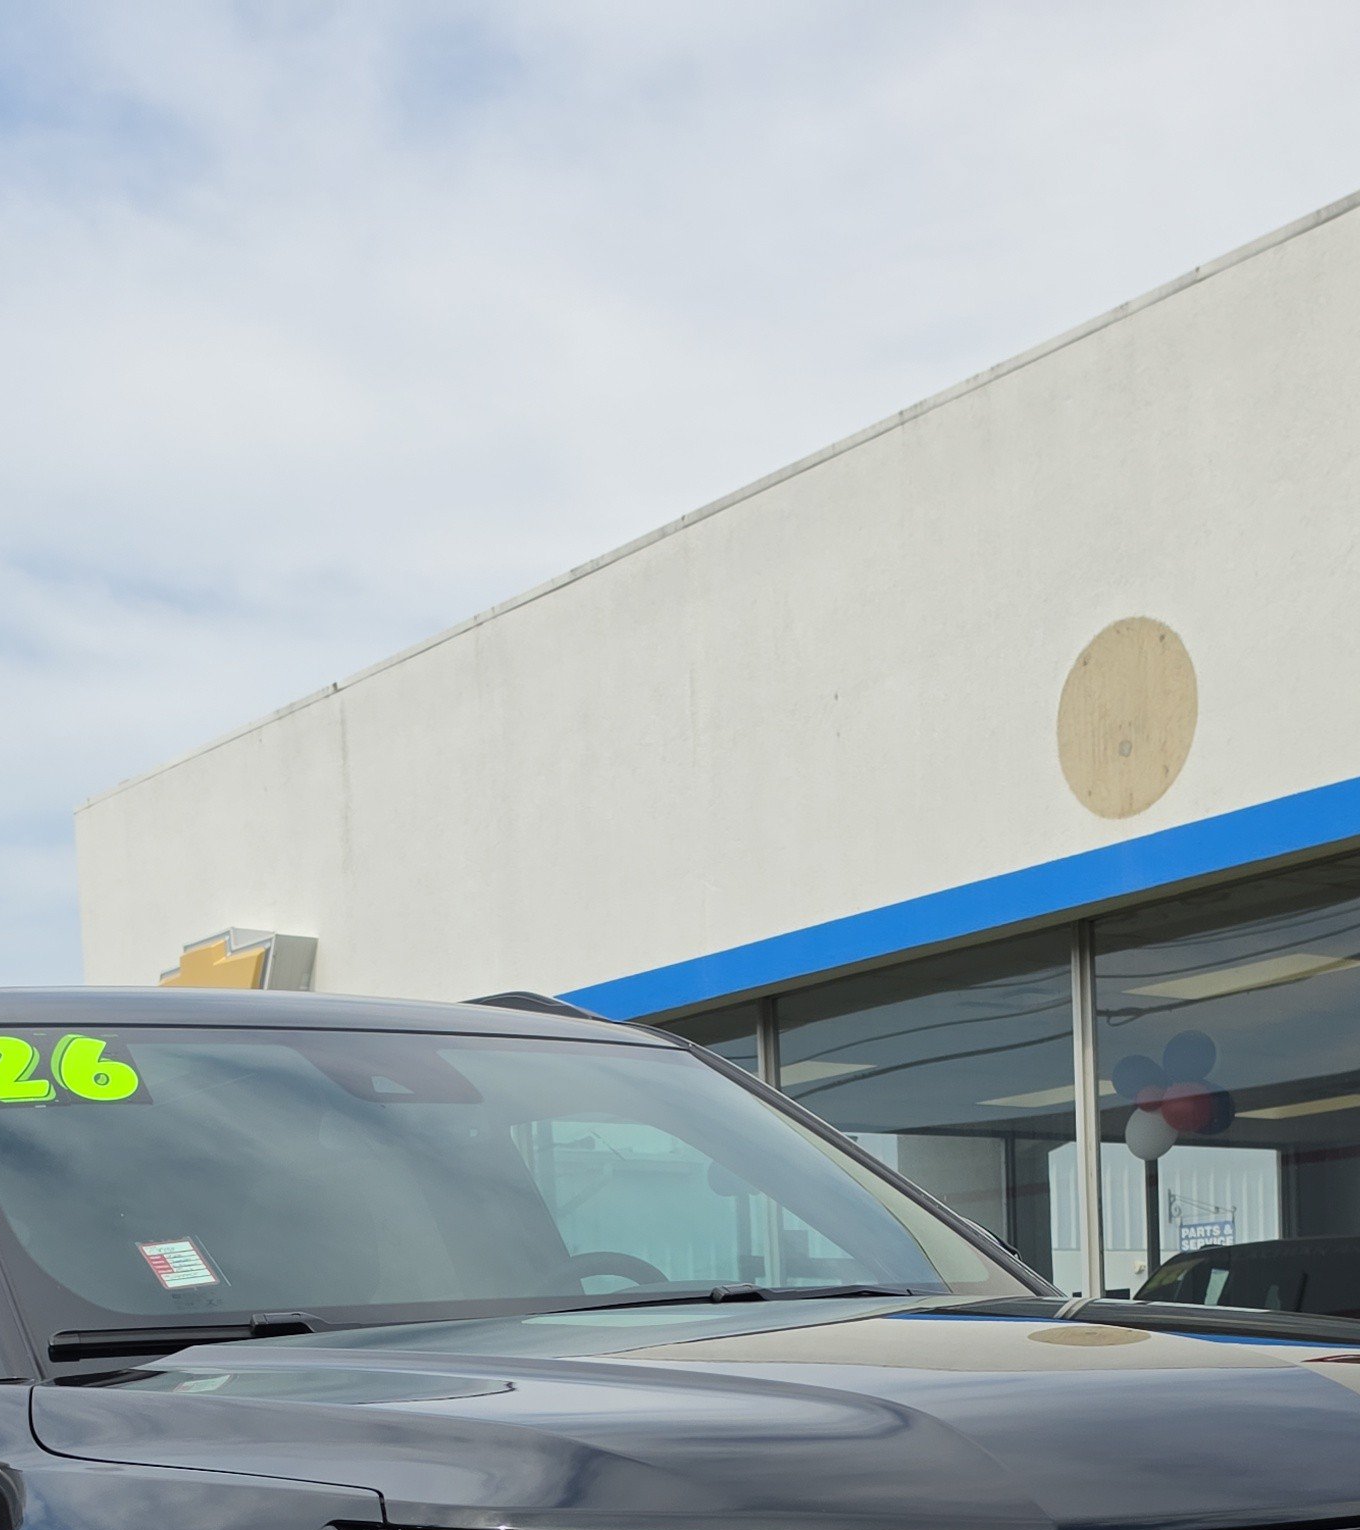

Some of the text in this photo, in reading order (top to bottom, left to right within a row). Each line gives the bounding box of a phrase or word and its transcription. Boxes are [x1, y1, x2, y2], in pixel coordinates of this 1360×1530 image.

[1181, 1223, 1233, 1239] PARTS &
[1181, 1236, 1234, 1251] SERVICE
